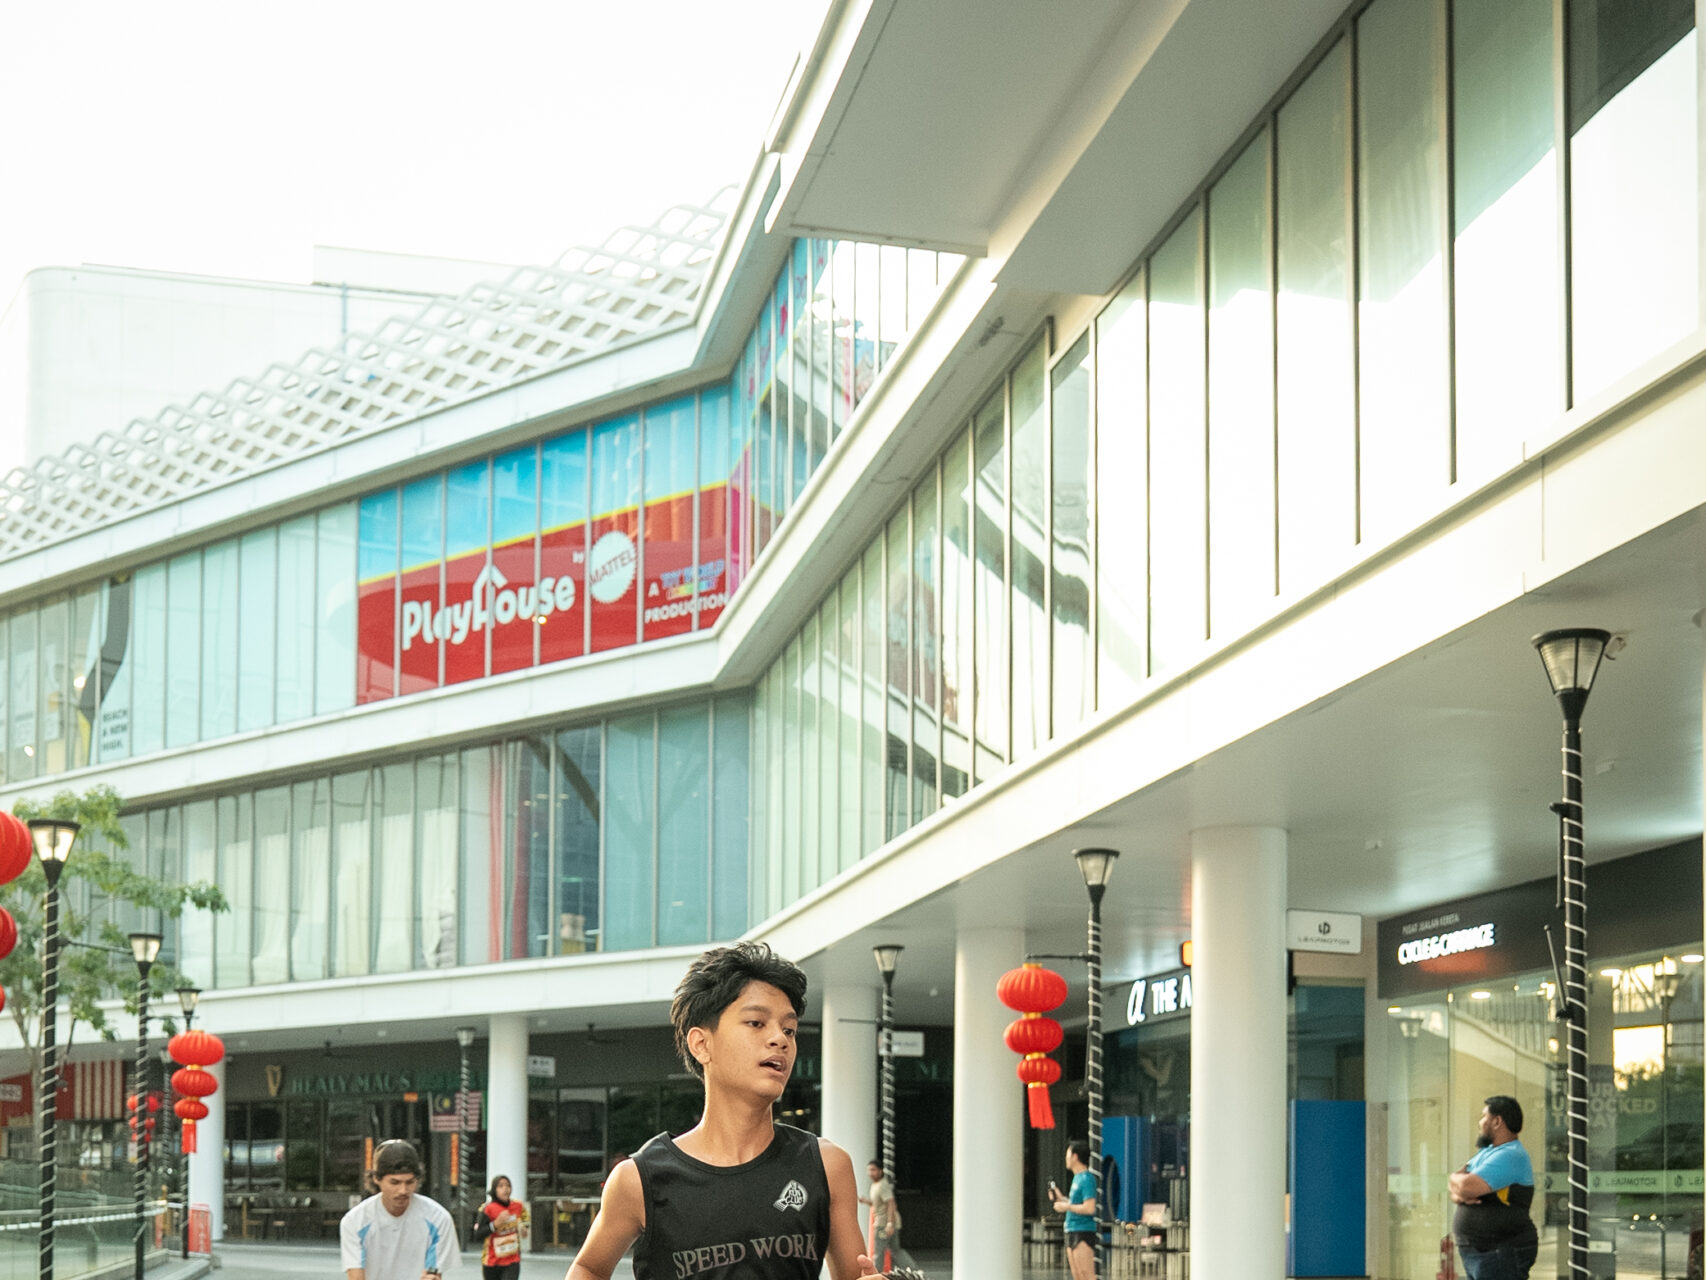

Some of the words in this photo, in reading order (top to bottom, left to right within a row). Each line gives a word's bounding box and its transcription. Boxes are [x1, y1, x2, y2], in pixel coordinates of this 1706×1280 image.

[590, 550, 637, 586] MATTEL
[648, 581, 660, 597] A
[644, 592, 729, 624] PRODUCTION
[1151, 978, 1178, 1014] THE
[672, 1242, 746, 1280] SPEED
[750, 1233, 818, 1261] WORK
